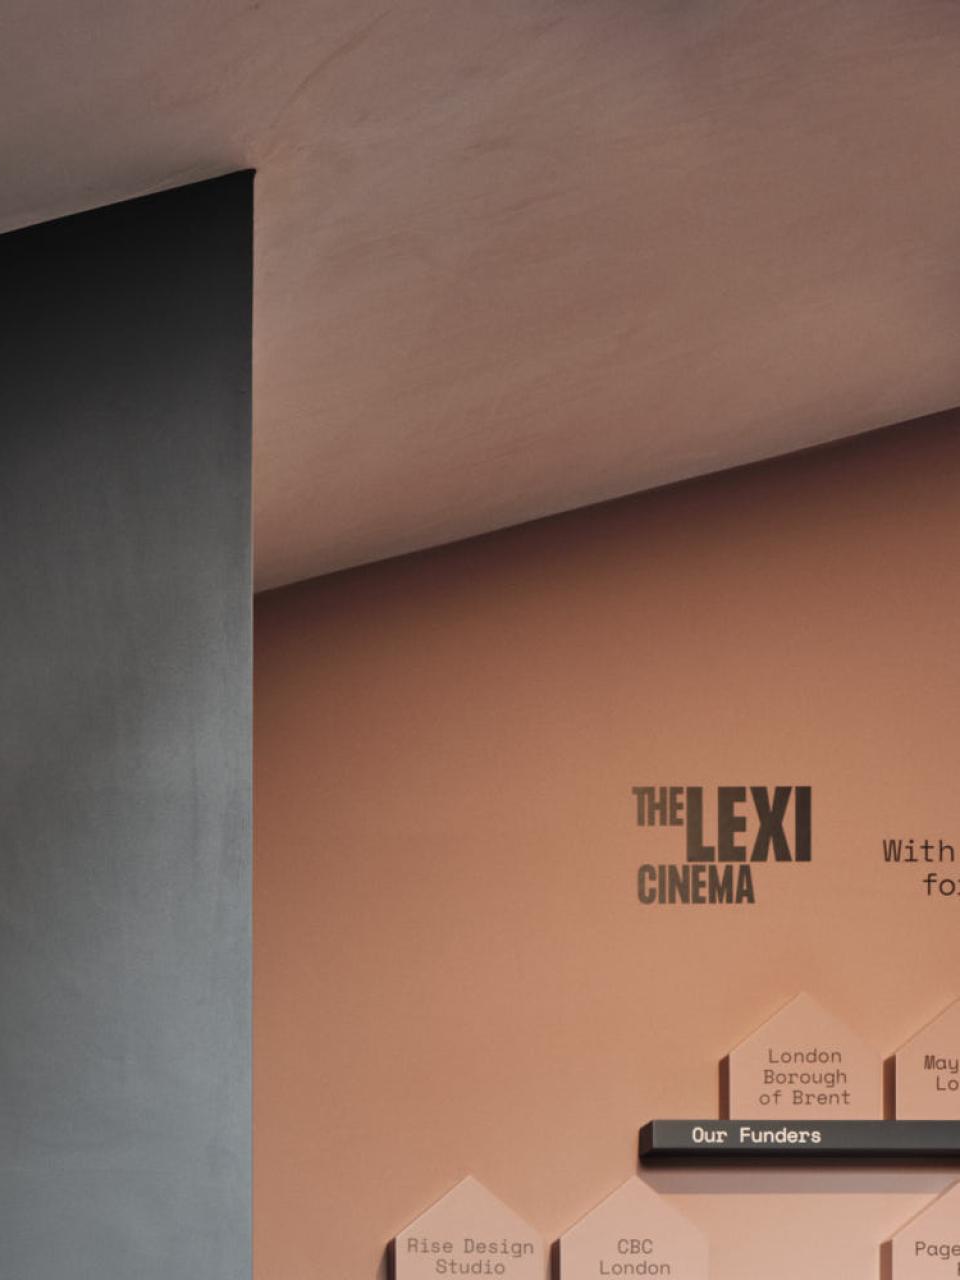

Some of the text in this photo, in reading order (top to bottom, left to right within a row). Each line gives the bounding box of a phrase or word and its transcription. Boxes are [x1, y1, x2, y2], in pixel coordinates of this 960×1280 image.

[632, 785, 812, 863] THE LEXI
[882, 839, 955, 863] With
[637, 863, 756, 905] CINEMA
[922, 872, 960, 897] fo
[768, 1047, 842, 1064] London
[763, 1068, 847, 1089] Borough
[758, 1089, 851, 1106] of Brent
[691, 1126, 822, 1144] Our Funders
[407, 1237, 535, 1259] Rise Design
[617, 1238, 654, 1255] CBC
[435, 1258, 506, 1276] Studio
[599, 1259, 671, 1276] London
